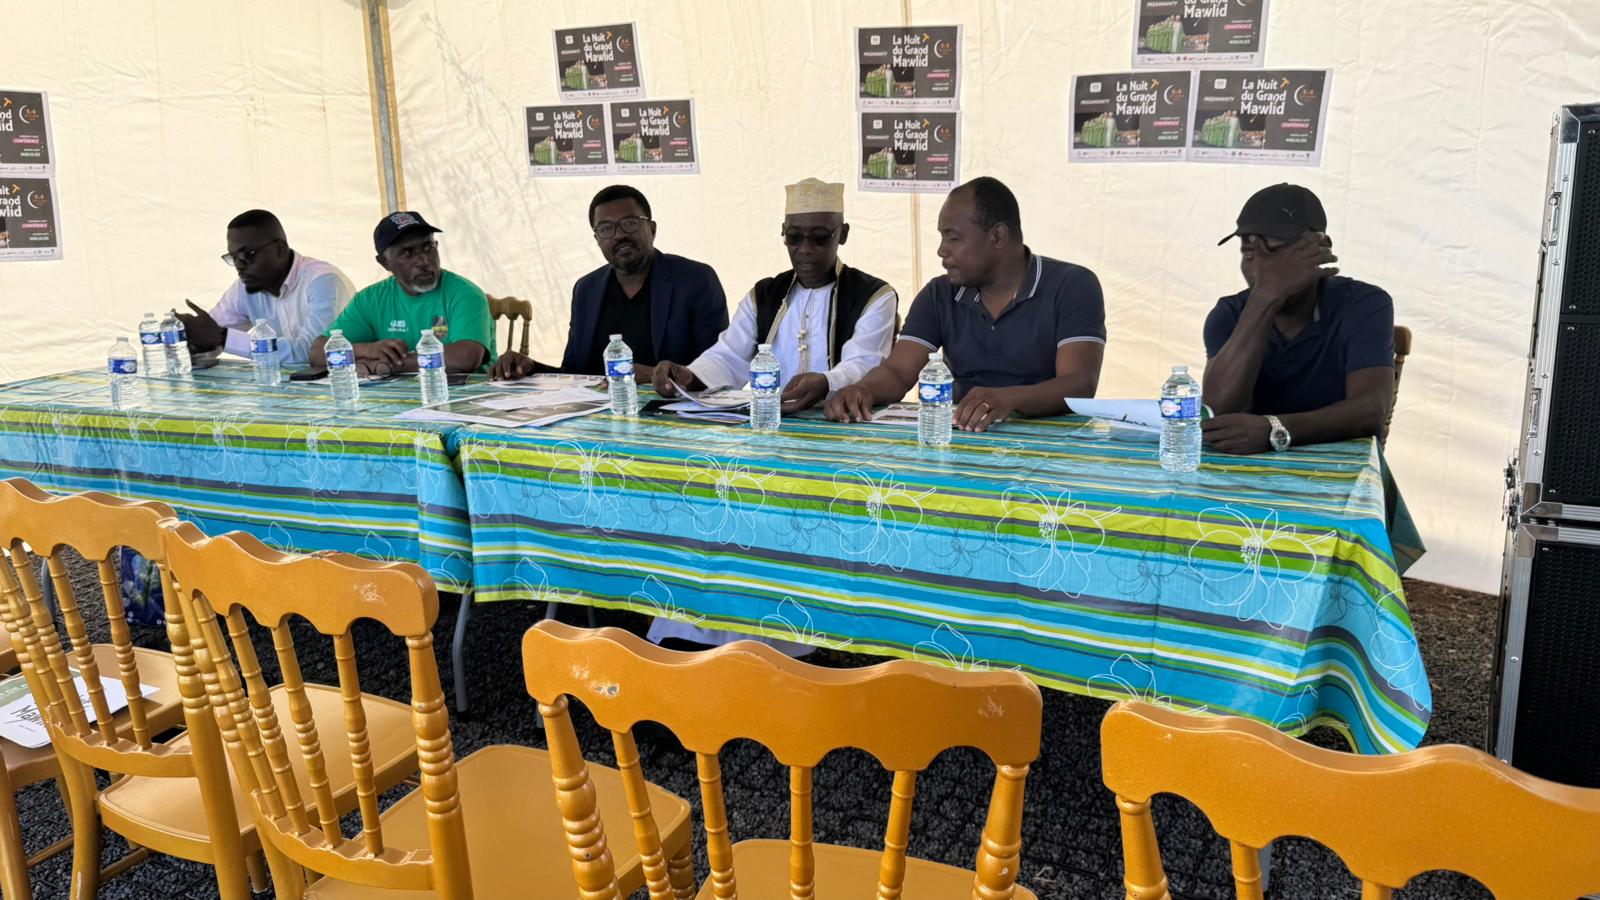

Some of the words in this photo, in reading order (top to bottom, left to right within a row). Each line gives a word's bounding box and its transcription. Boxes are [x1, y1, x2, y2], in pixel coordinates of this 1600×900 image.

[1184, 3, 1228, 18] Mawlid
[892, 35, 902, 45] La
[903, 34, 921, 44] Nuit
[892, 46, 903, 54] du
[904, 44, 929, 55] Grand
[892, 54, 929, 67] Mawlid
[1116, 81, 1127, 92] La
[1129, 80, 1148, 91] Nuit
[1241, 78, 1254, 90] La
[1256, 78, 1278, 90] Nuit
[1116, 92, 1128, 102] du
[1130, 90, 1157, 102] Grand
[1241, 90, 1254, 101] du
[1256, 90, 1287, 102] Grand
[1116, 101, 1156, 115] Mawlid
[1240, 101, 1286, 115] Mawlid
[894, 120, 903, 129] La
[904, 120, 921, 129] Nuit
[894, 130, 904, 139] du
[905, 129, 929, 140] Grand
[894, 139, 928, 151] Mawlid
